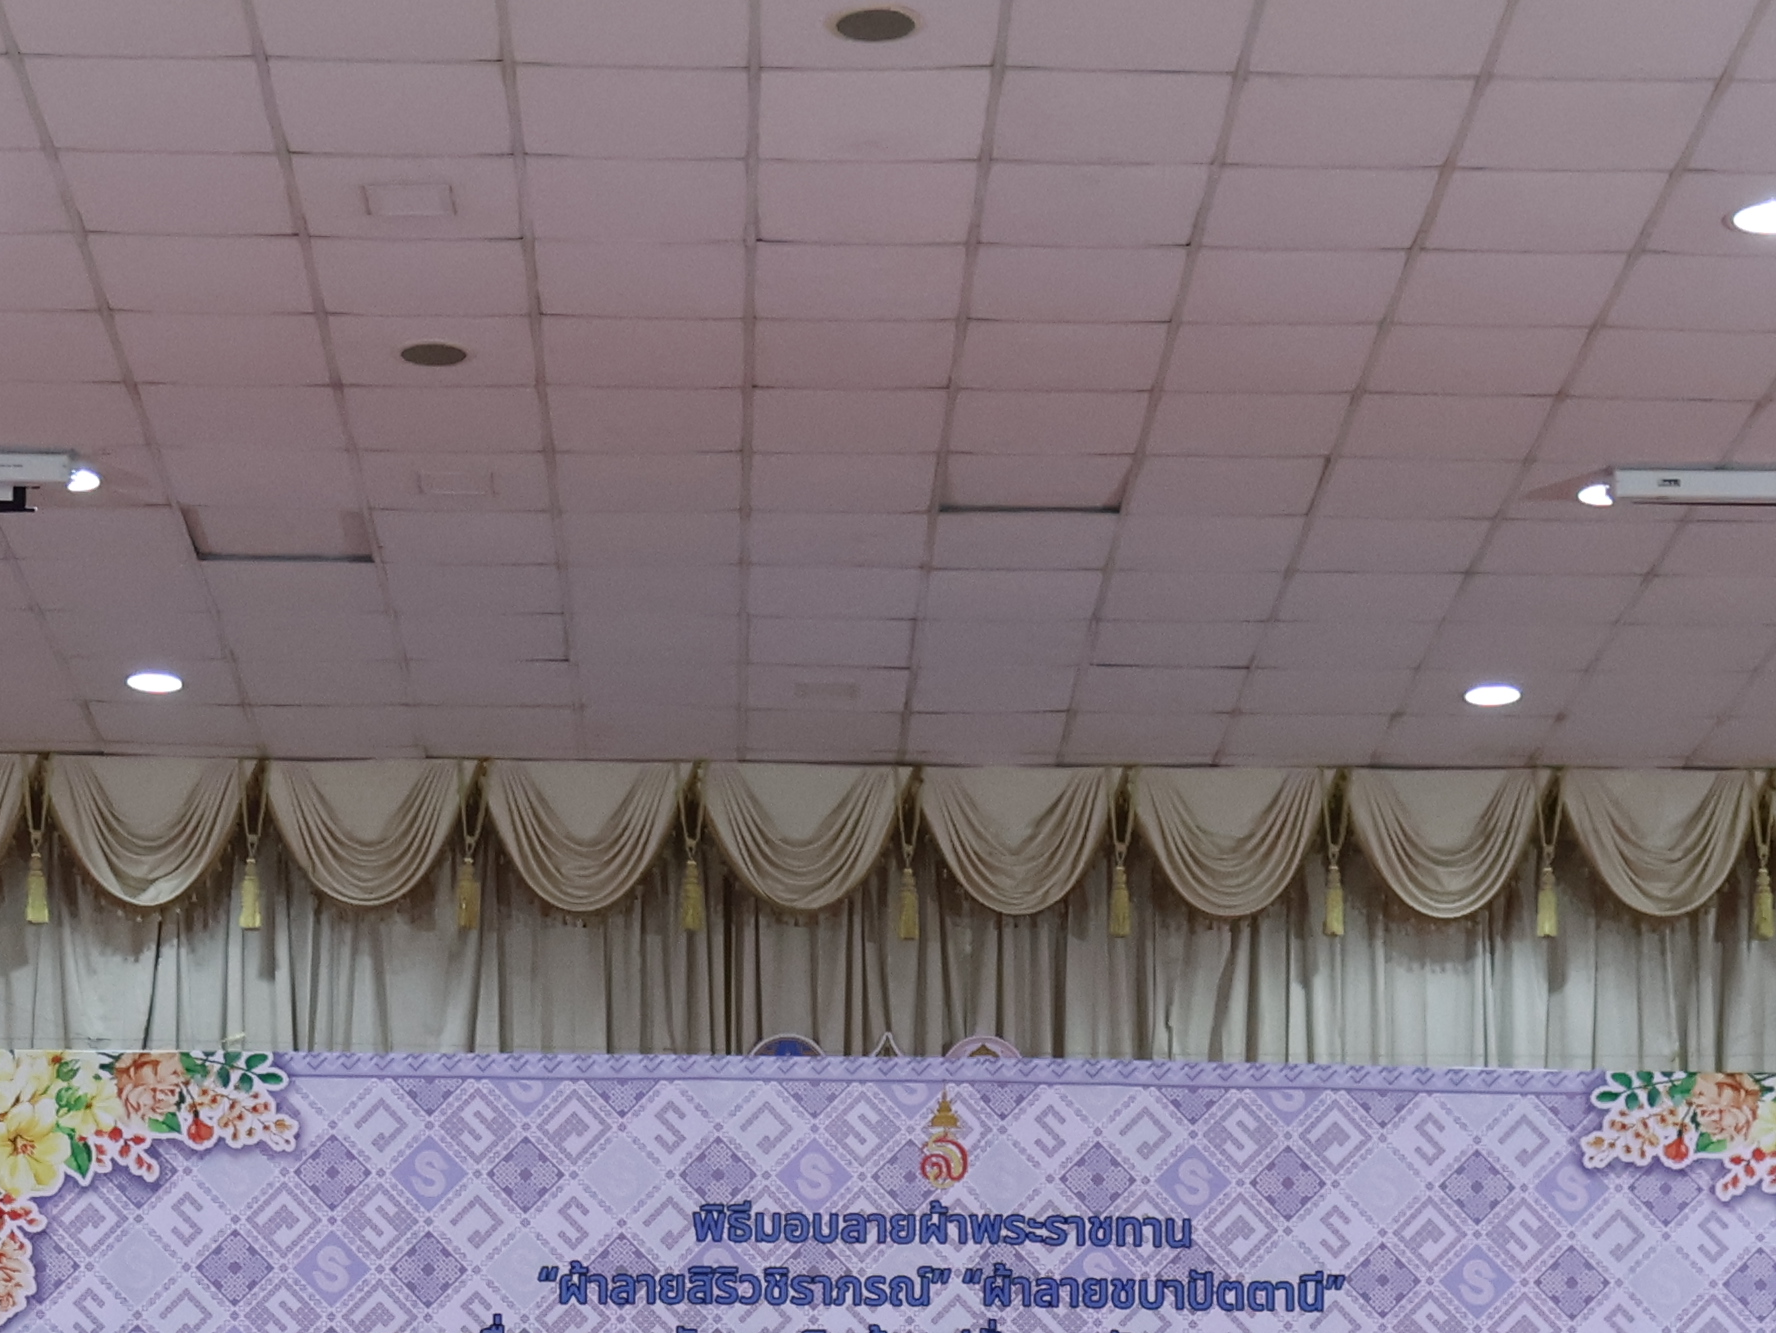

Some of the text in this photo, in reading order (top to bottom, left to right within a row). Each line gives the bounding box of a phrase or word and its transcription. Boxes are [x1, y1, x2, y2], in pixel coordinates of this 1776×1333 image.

[692, 1200, 1193, 1249] พิธีมอบลายผ้าพระราชทาน
